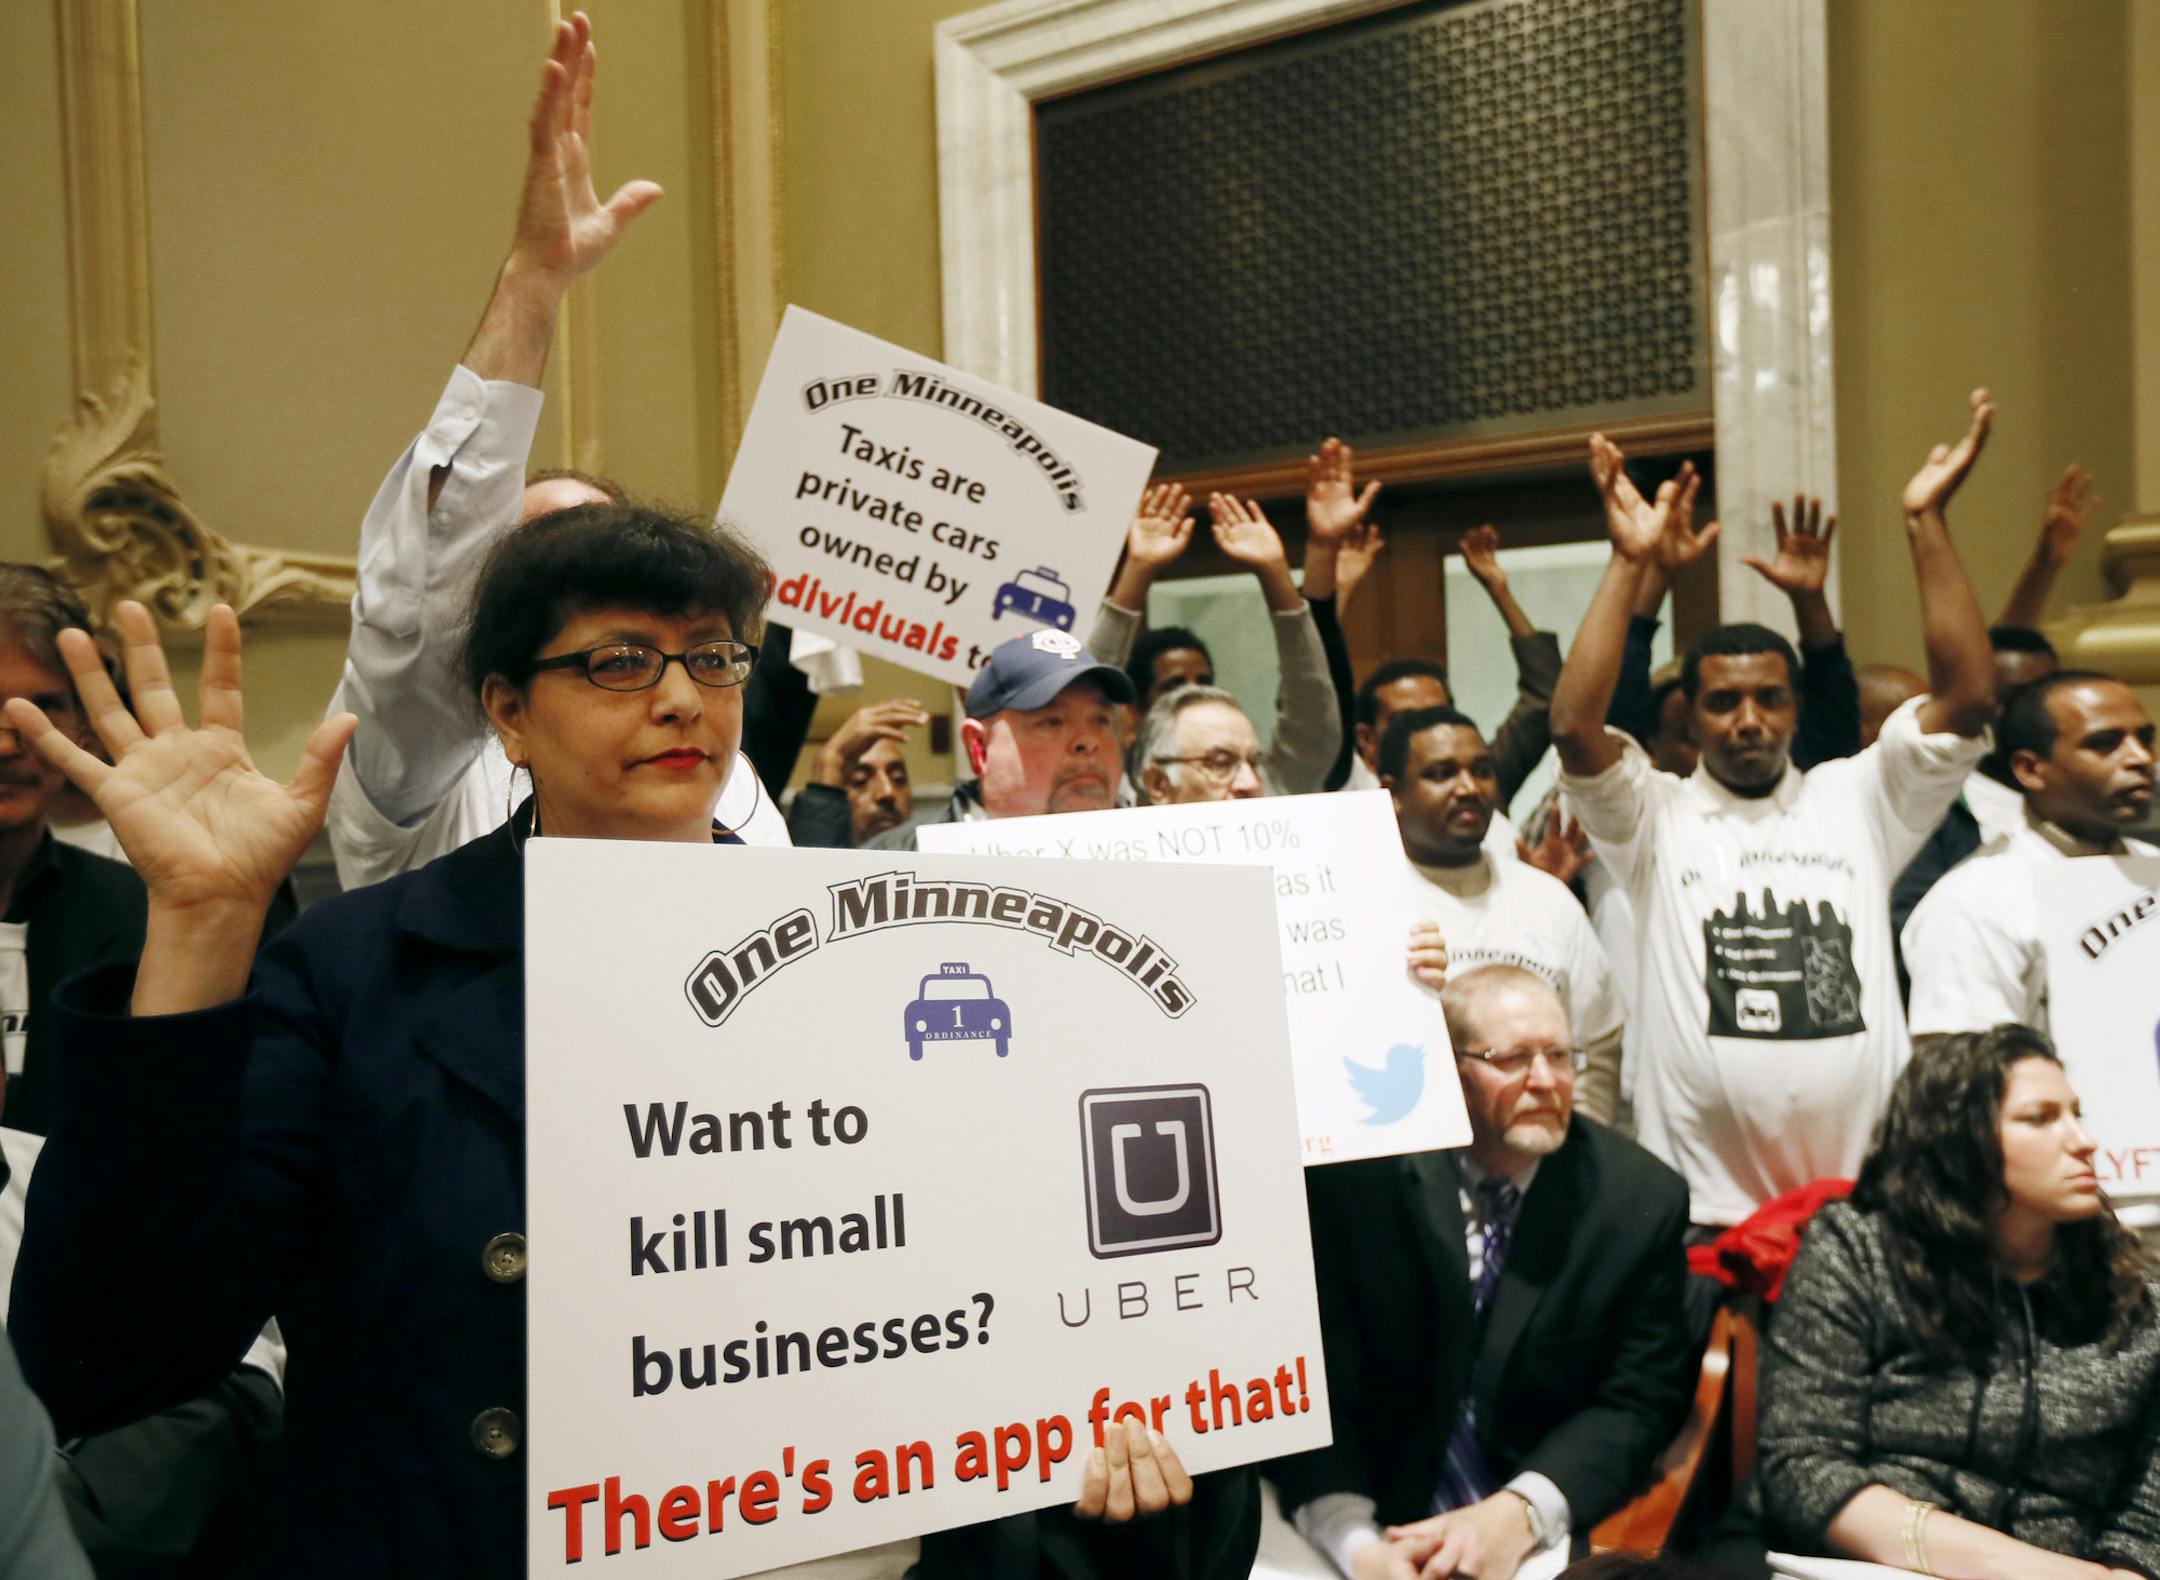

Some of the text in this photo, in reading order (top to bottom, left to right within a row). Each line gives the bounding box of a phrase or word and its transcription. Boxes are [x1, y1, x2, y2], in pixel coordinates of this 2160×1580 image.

[803, 369, 1085, 513] One Minneapolis
[841, 424, 986, 504] Taxis are
[796, 471, 1000, 561] private cars
[800, 526, 969, 605] owned by
[1055, 837, 1075, 860] X
[1087, 838, 1148, 862] was
[1157, 824, 1223, 858] NOT
[1236, 819, 1302, 852] 10%
[1317, 863, 1337, 893] it
[684, 871, 1197, 1027] One Minneapolis
[1286, 918, 1345, 943] was
[2078, 890, 2157, 962] One
[942, 965, 967, 975] TAXI
[925, 1030, 993, 1040] ORDINANCE
[951, 1005, 965, 1028] 1
[623, 1099, 869, 1159] Want to
[1300, 1135, 1335, 1157] rg
[630, 1193, 906, 1276] kill small
[1057, 1266, 1260, 1328] UBER
[632, 1292, 996, 1398] businesses?
[547, 1446, 833, 1565] There's
[853, 1439, 935, 1503] an
[955, 1413, 1073, 1492] app
[1185, 1356, 1311, 1435] that!
